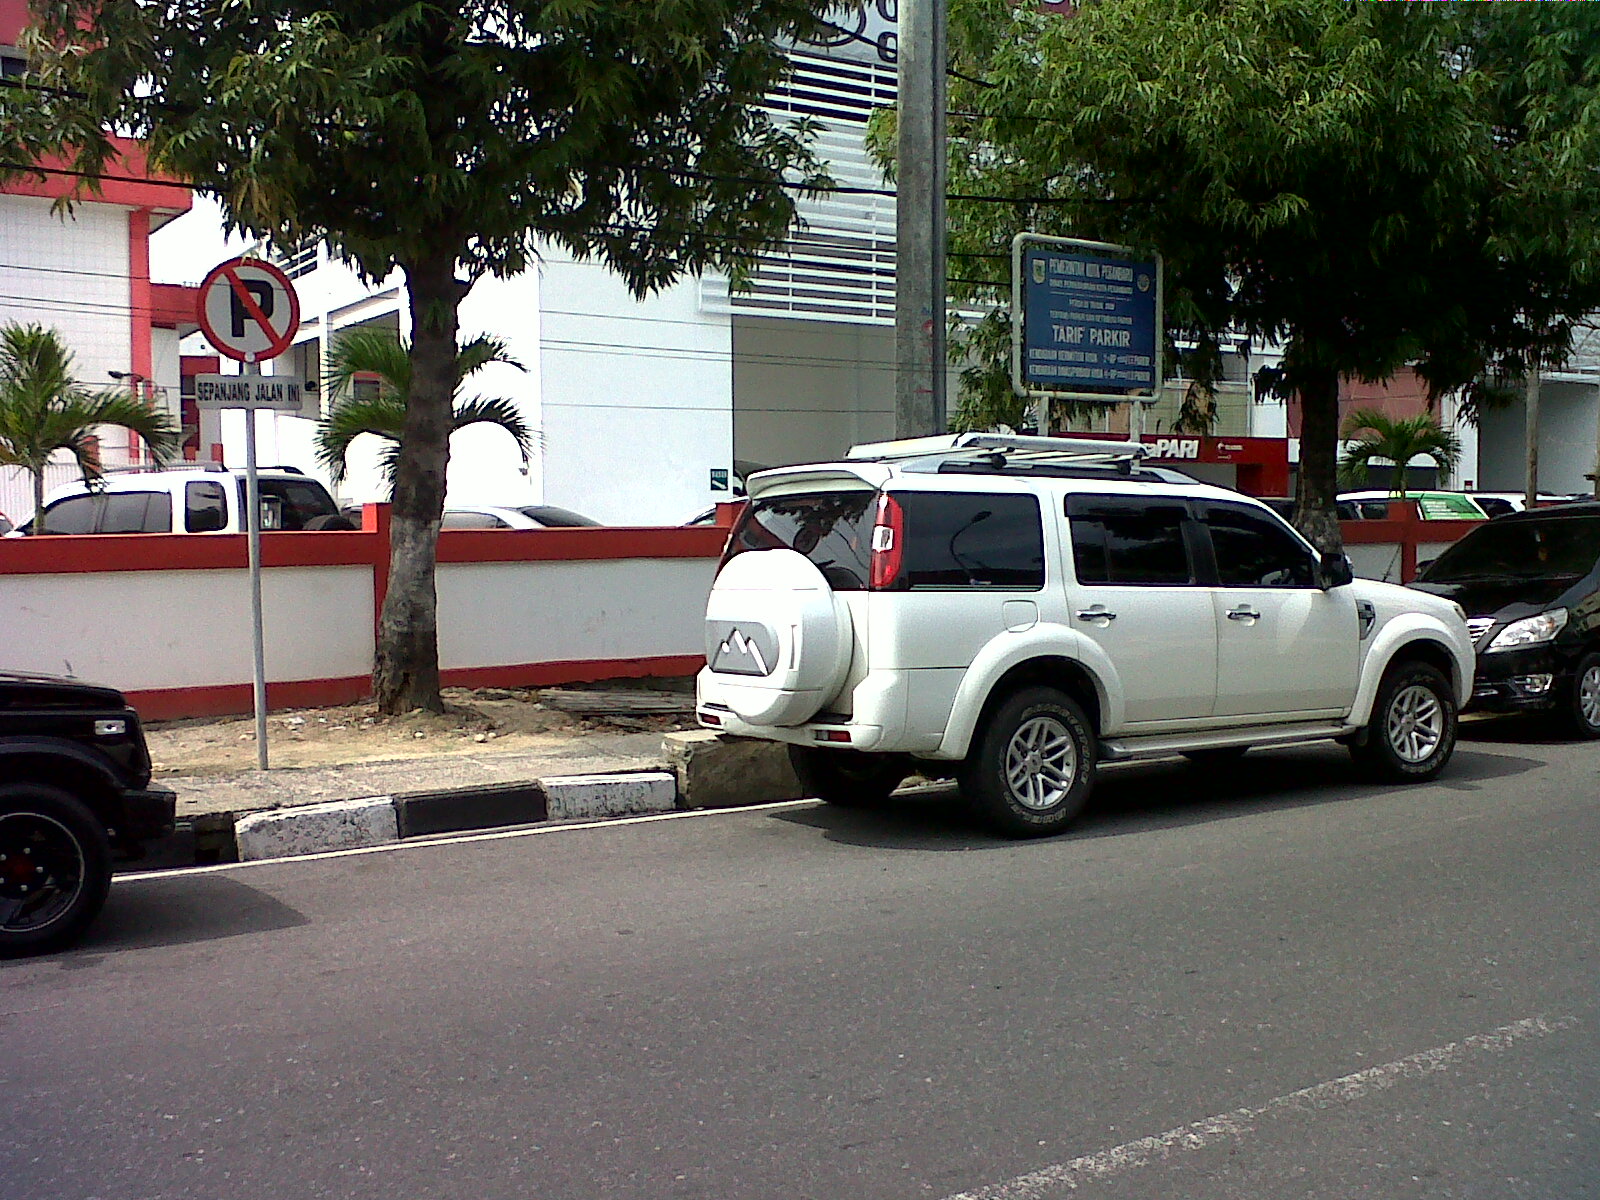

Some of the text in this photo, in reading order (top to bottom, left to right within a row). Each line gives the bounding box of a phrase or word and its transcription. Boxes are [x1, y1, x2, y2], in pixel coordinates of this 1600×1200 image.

[230, 279, 274, 337] P
[1052, 324, 1130, 347] TARIF PARKIR
[197, 382, 300, 402] SEPANJANG JALAN INI
